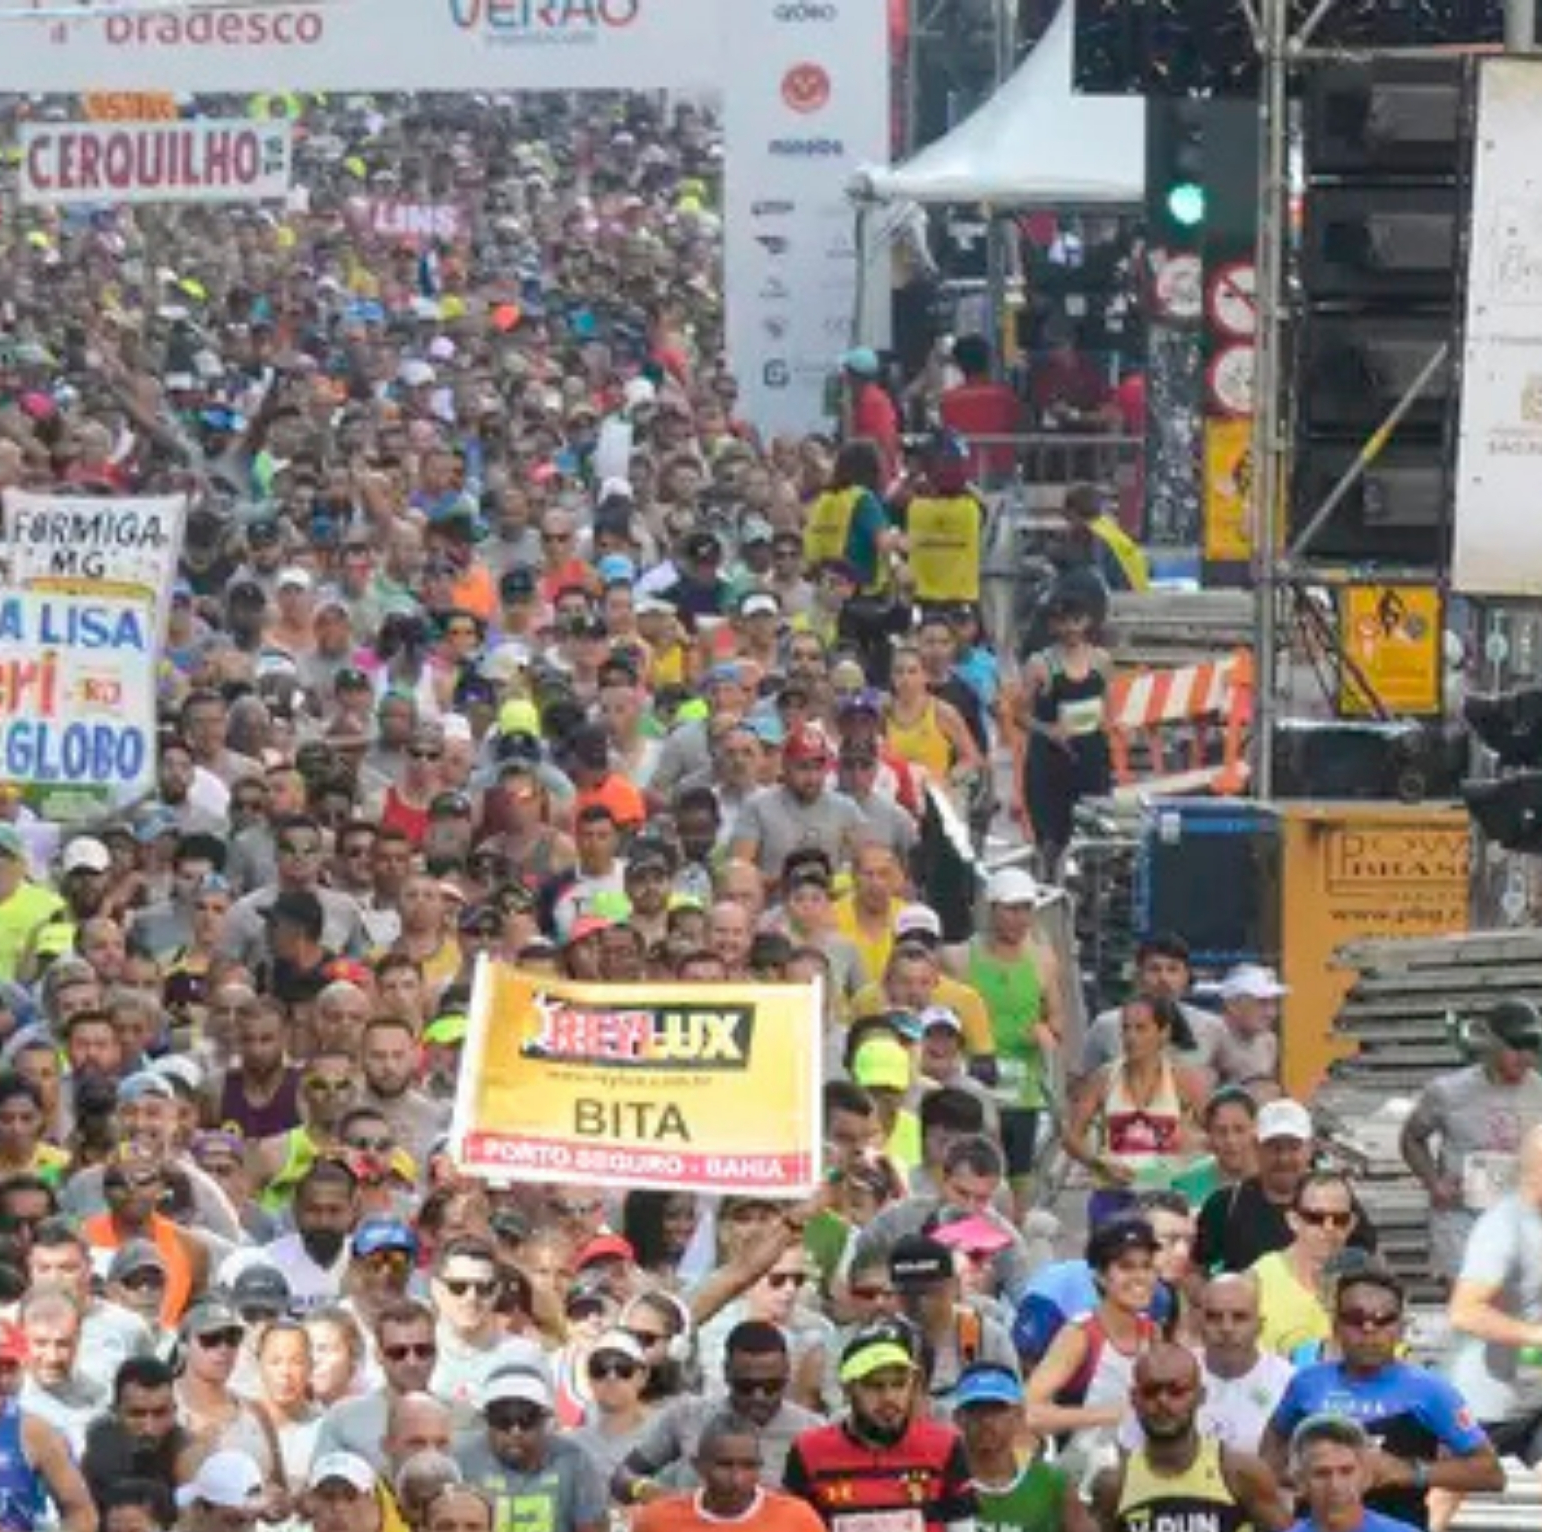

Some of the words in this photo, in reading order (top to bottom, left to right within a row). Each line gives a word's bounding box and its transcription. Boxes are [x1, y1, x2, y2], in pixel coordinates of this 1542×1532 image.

[27, 130, 259, 190] CERQUILHO
[51, 551, 105, 577] MG
[40, 602, 144, 650] LISA
[5, 722, 144, 781] GLOBO
[574, 1099, 691, 1142] BITA
[484, 1138, 571, 1169] PORTO
[574, 1147, 685, 1176] SEGURO
[705, 1155, 785, 1180] BAHIA
